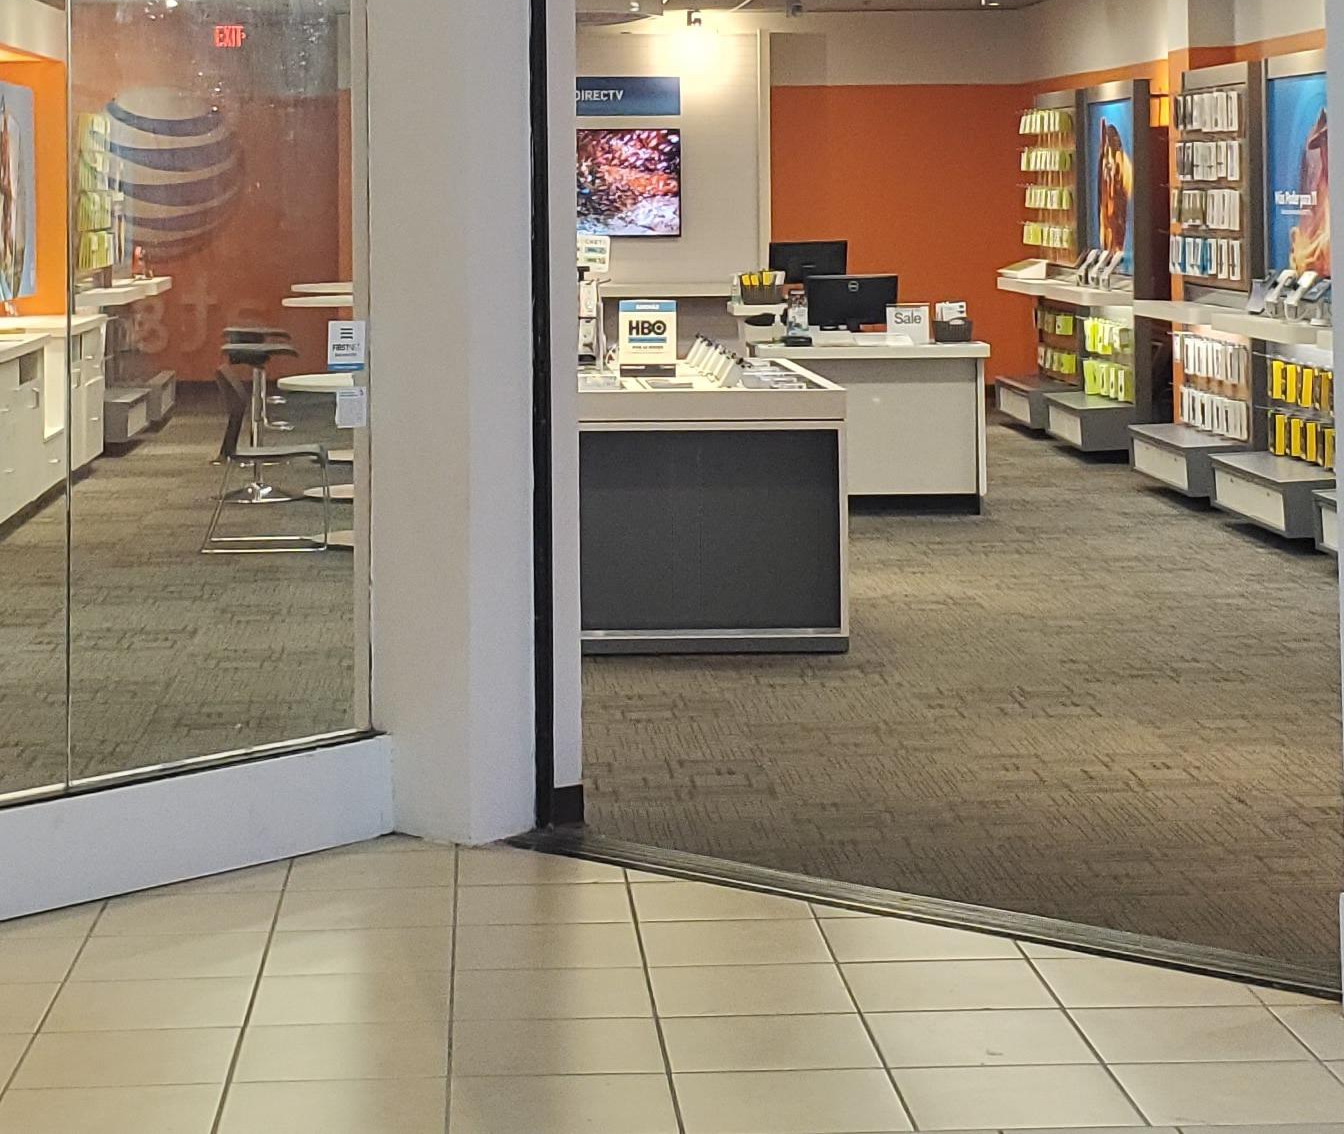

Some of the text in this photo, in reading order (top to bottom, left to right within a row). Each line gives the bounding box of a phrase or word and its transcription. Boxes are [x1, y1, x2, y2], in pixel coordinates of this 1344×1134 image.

[215, 25, 244, 47] EXIT
[894, 309, 922, 325] Sale
[628, 320, 667, 336] HBO
